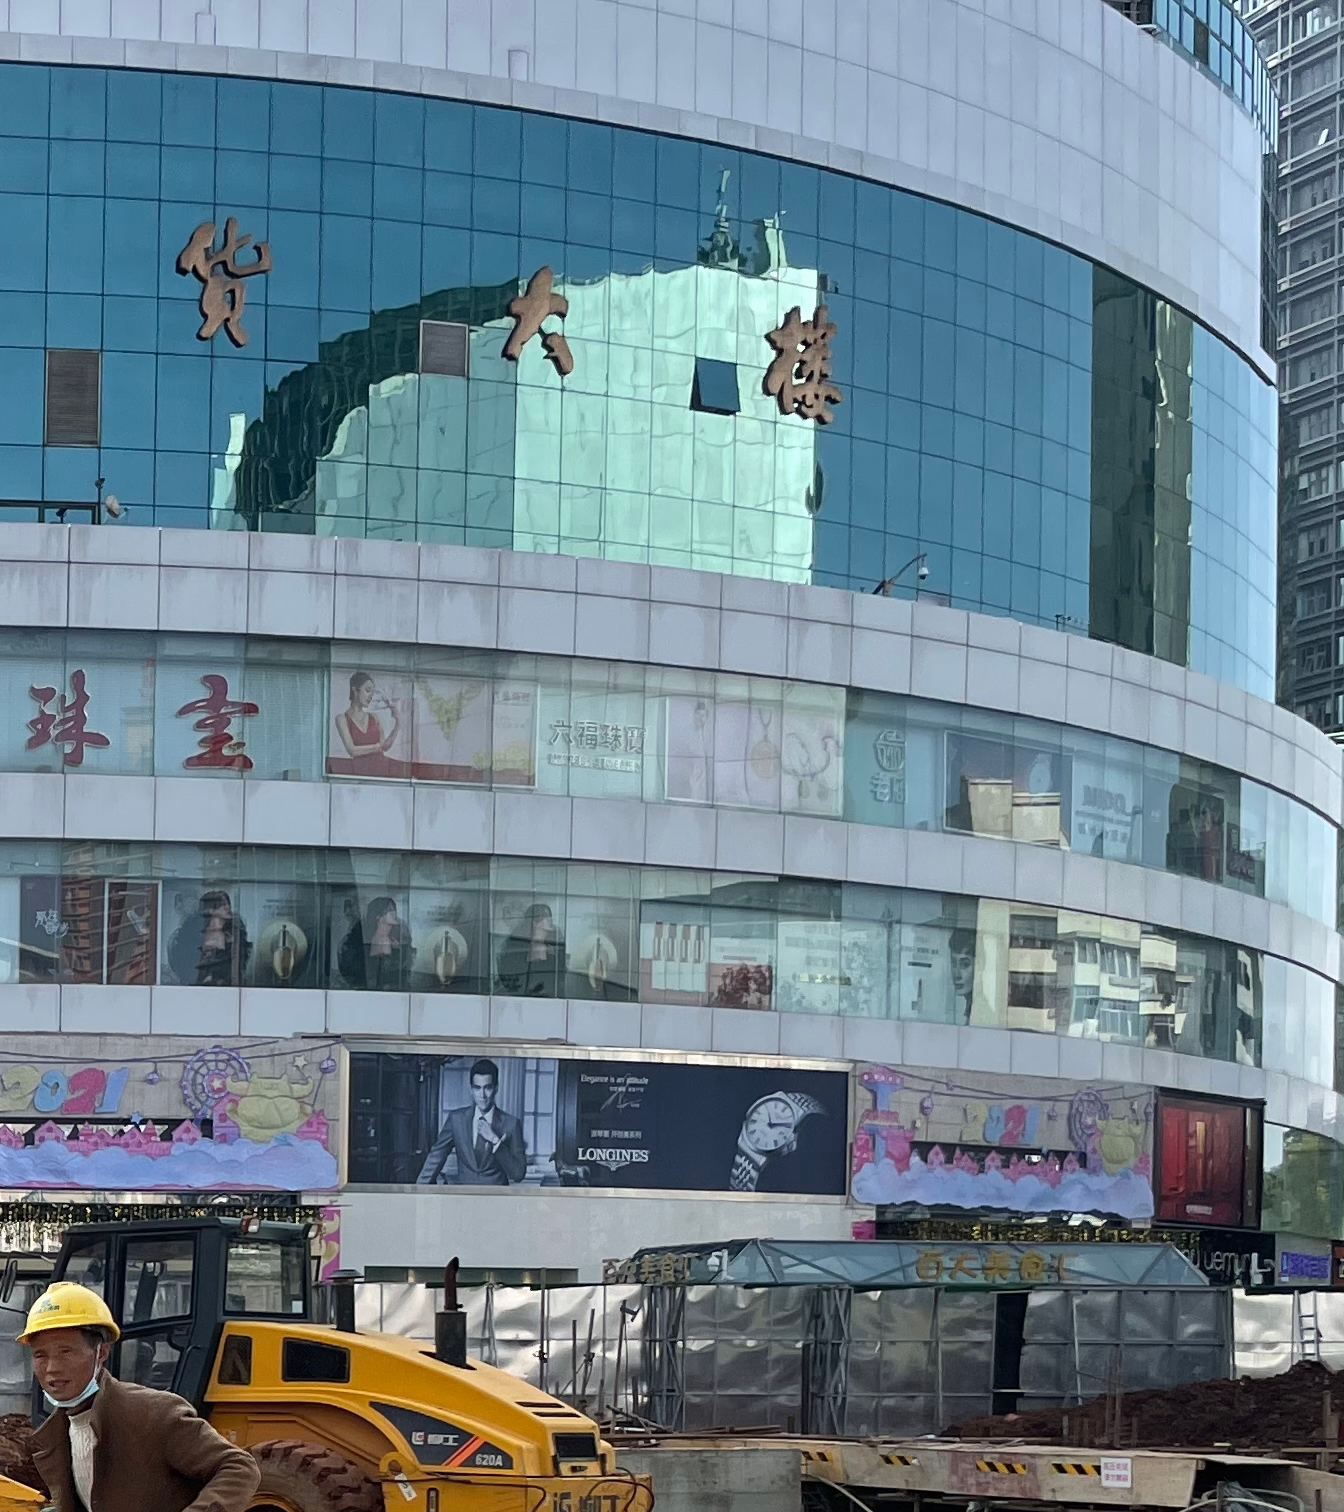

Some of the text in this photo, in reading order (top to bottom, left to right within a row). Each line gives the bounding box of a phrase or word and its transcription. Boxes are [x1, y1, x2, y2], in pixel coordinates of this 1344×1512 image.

[959, 1104, 1042, 1147] 2021
[577, 1147, 650, 1163] LONGINES
[475, 1453, 503, 1467] 620A
